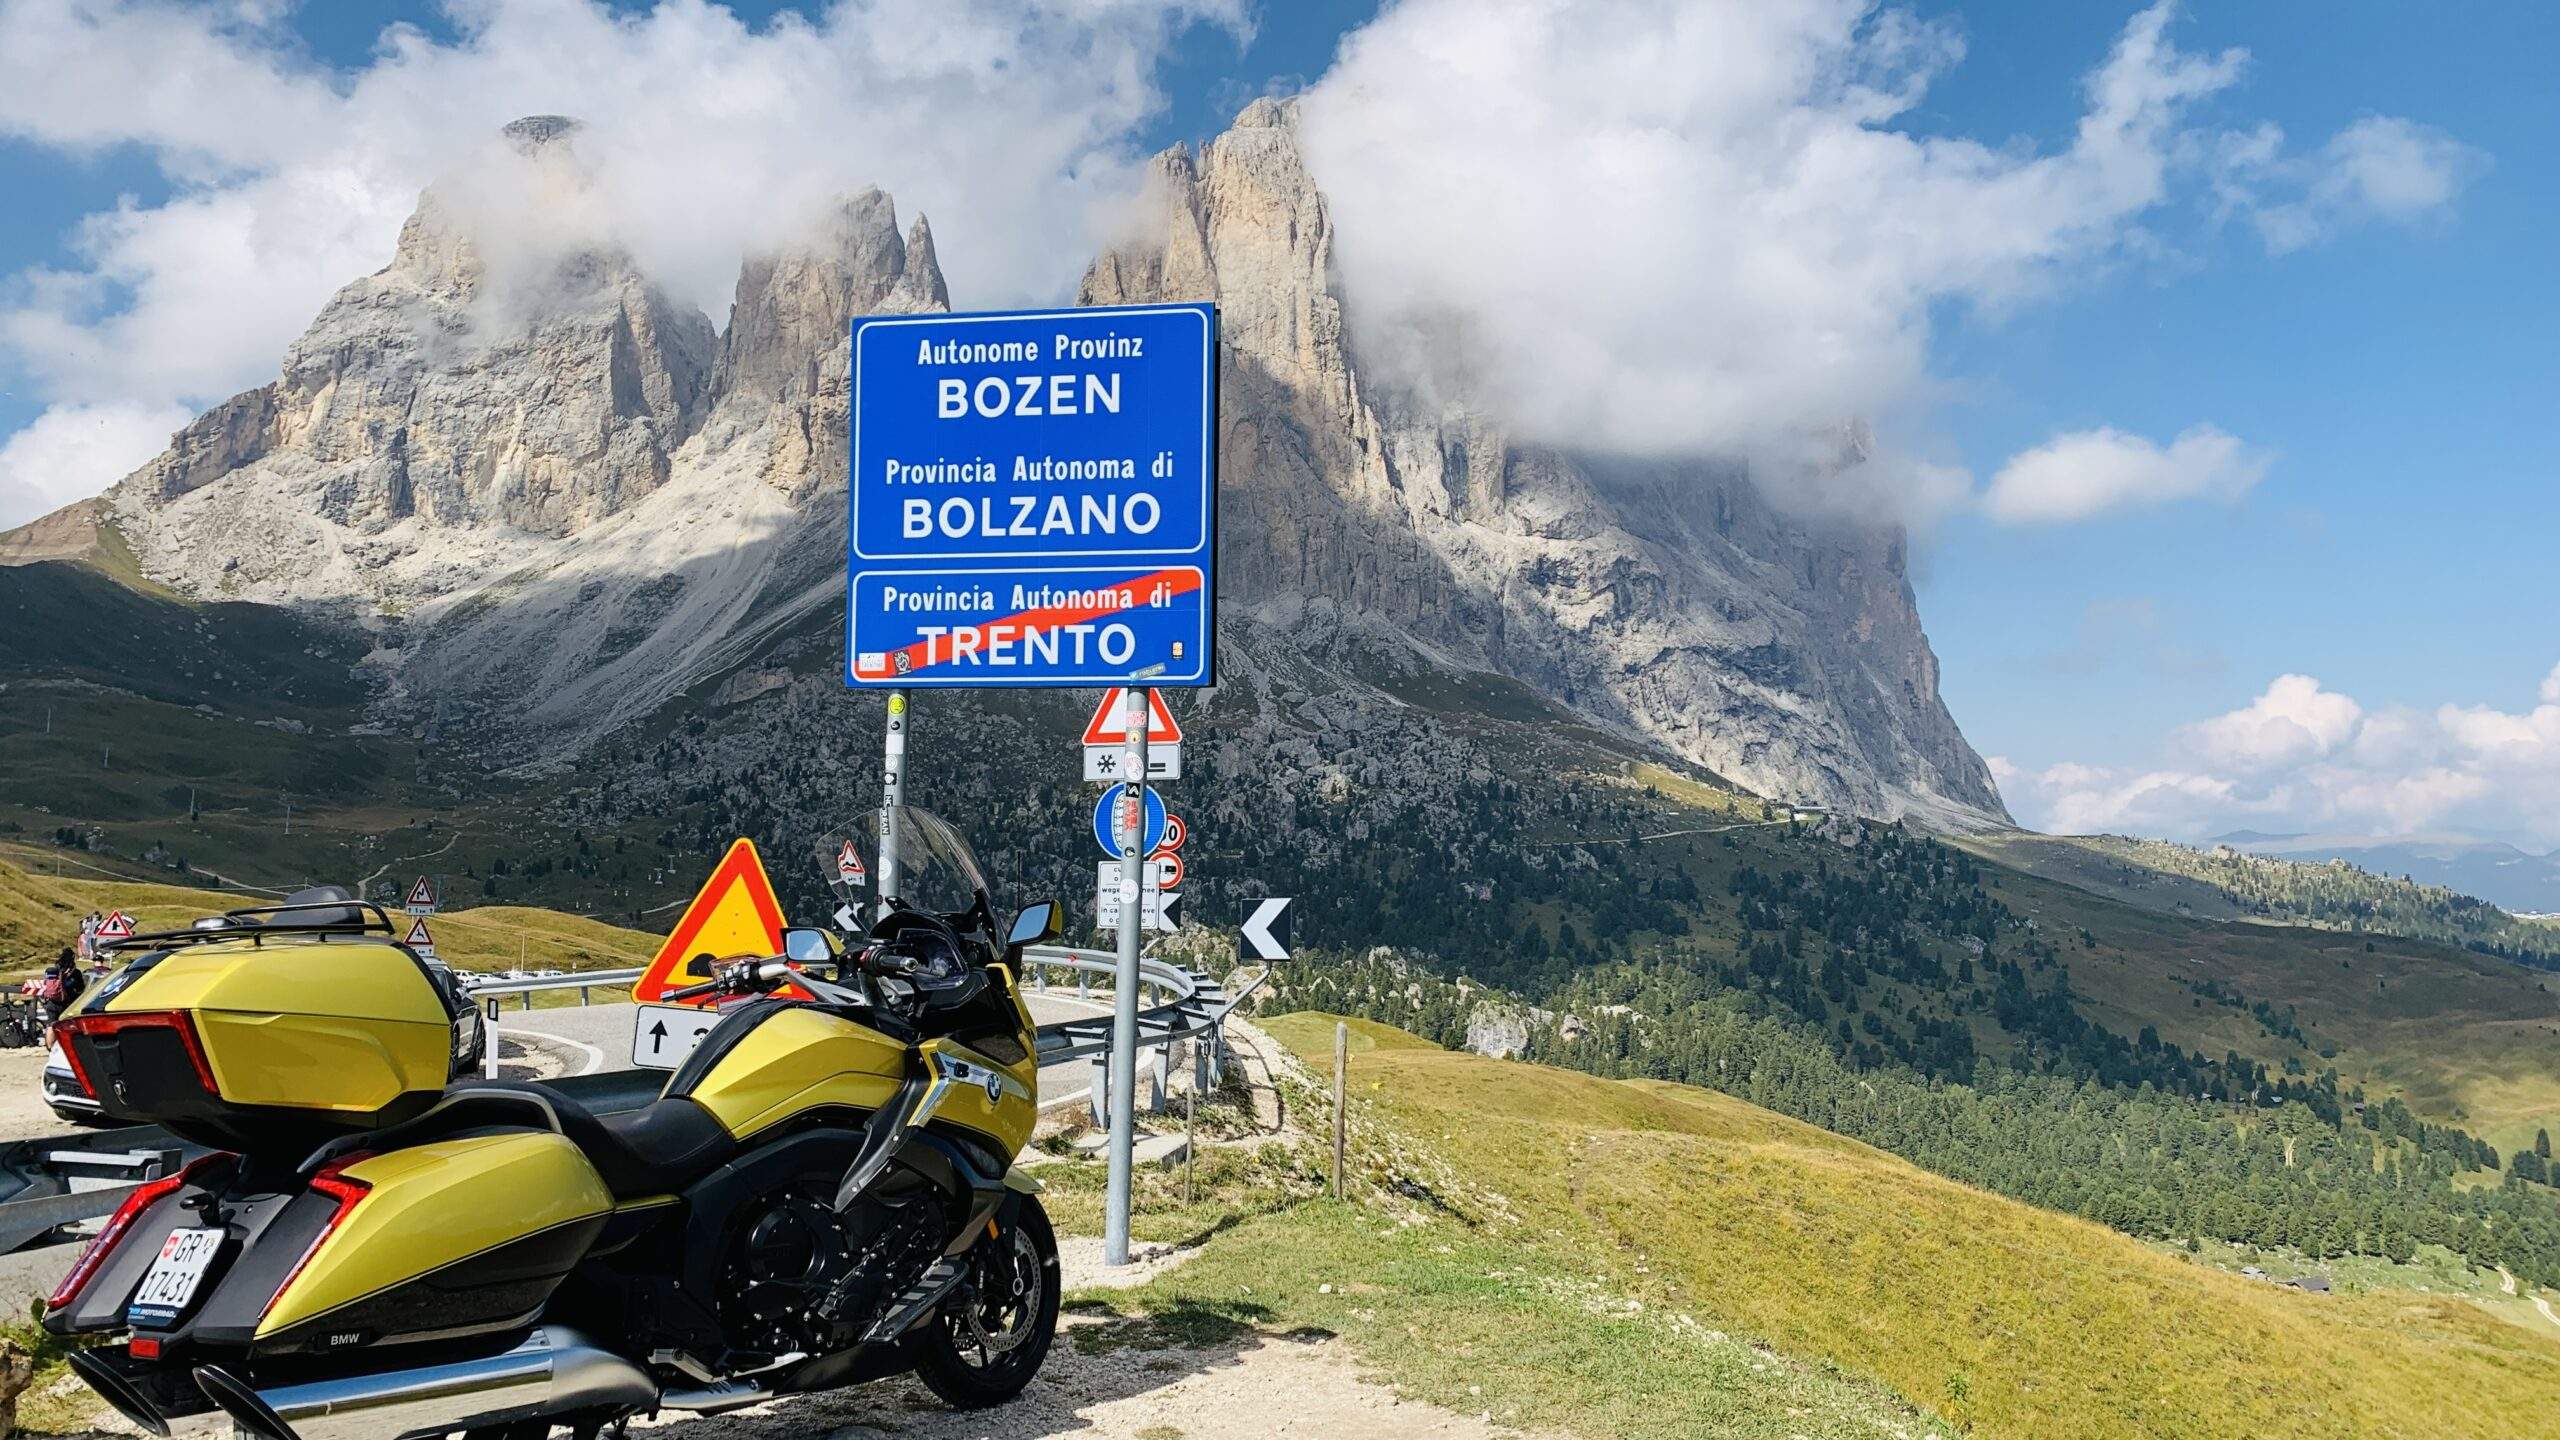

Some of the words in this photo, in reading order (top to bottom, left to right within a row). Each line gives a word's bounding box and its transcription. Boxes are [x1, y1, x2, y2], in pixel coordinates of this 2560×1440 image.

[918, 338, 1039, 365] Autonome
[1055, 331, 1143, 360] Provinz
[938, 373, 1120, 419] BOZEN
[886, 456, 996, 484] Provincia
[1012, 456, 1135, 481] Autonoma
[1151, 451, 1173, 478] di
[903, 492, 1161, 538] BOLZANO
[883, 584, 994, 611] Provincia
[1011, 584, 1133, 610] Autonoma
[1150, 581, 1171, 608] di
[916, 623, 1136, 665] TRENTO
[1162, 825, 1178, 841] 0
[174, 1233, 204, 1262] GR
[140, 1271, 195, 1302] 17431
[330, 1333, 360, 1346] BMW
